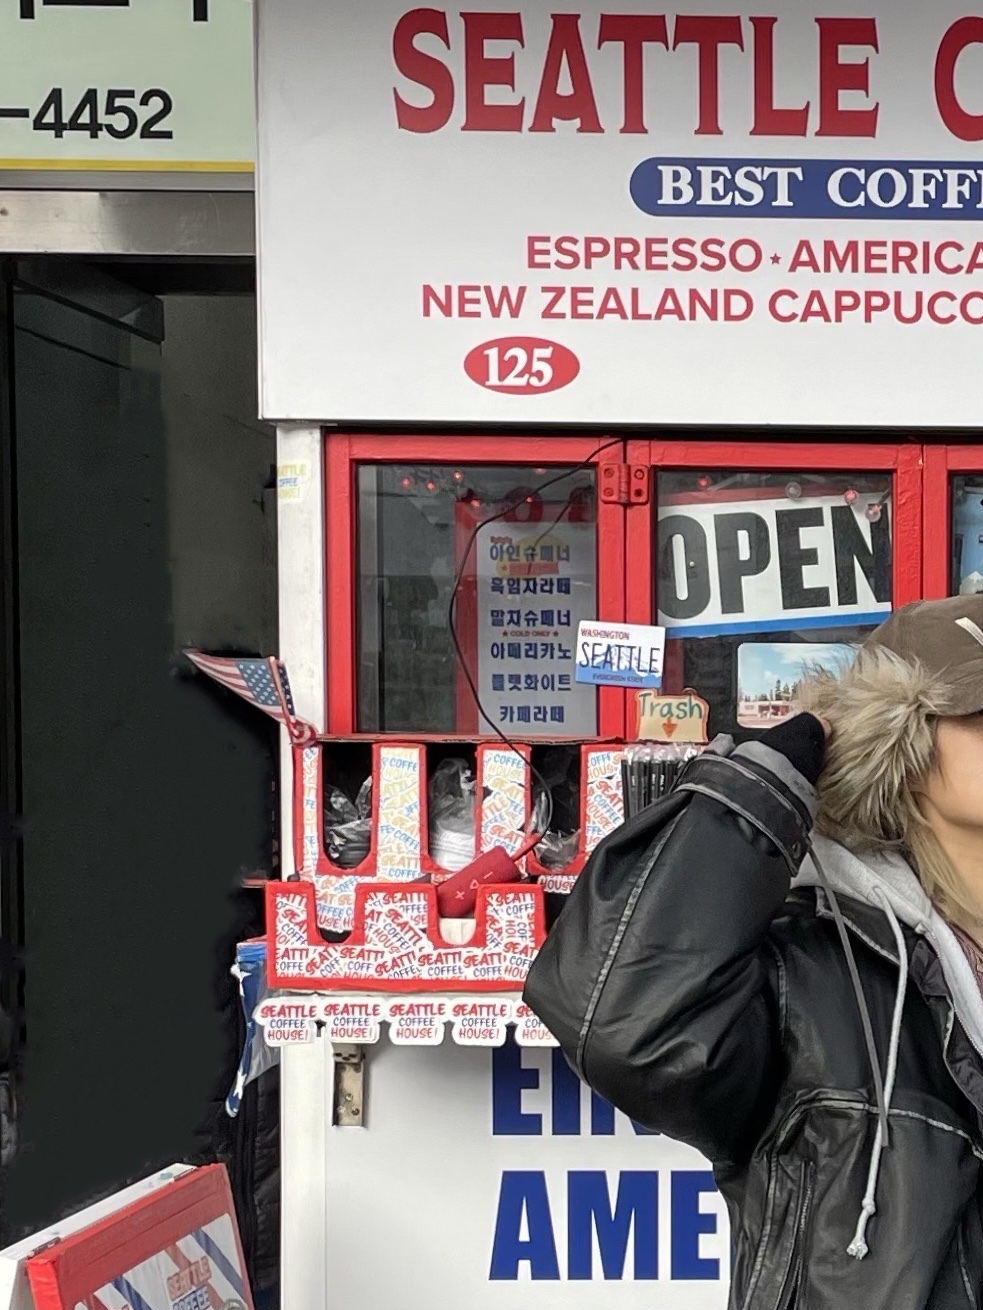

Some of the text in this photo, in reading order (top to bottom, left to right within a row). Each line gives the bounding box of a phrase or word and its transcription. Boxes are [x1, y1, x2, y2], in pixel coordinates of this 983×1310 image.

[394, 9, 878, 141] SEATTLE
[657, 165, 803, 208] BEST
[528, 236, 763, 273] ESPRESSO
[422, 285, 534, 320] NEW
[540, 287, 755, 322] ZEALAND
[482, 347, 554, 388] 125
[657, 503, 893, 619] OPEN
[580, 627, 630, 641] WASHINGTON
[579, 641, 661, 674] SEATTLE
[639, 692, 703, 720] Trash
[260, 1004, 317, 1019] SEATTLE
[323, 1003, 381, 1017] SEATTLE
[389, 1002, 446, 1018] SEATTLE
[452, 1003, 508, 1018] SEATTLE
[269, 1019, 307, 1029] COFFEE
[332, 1016, 370, 1027] COFFEE
[398, 1017, 436, 1027] COFFEE
[461, 1017, 498, 1028] COFFEE
[267, 1029, 309, 1041] HOUSE!
[330, 1027, 373, 1038] HOUSE!
[395, 1027, 438, 1040] HOUSE!
[458, 1028, 500, 1041] HOUSE!
[521, 1028, 552, 1041] HOUS
[489, 1170, 721, 1282] AME
